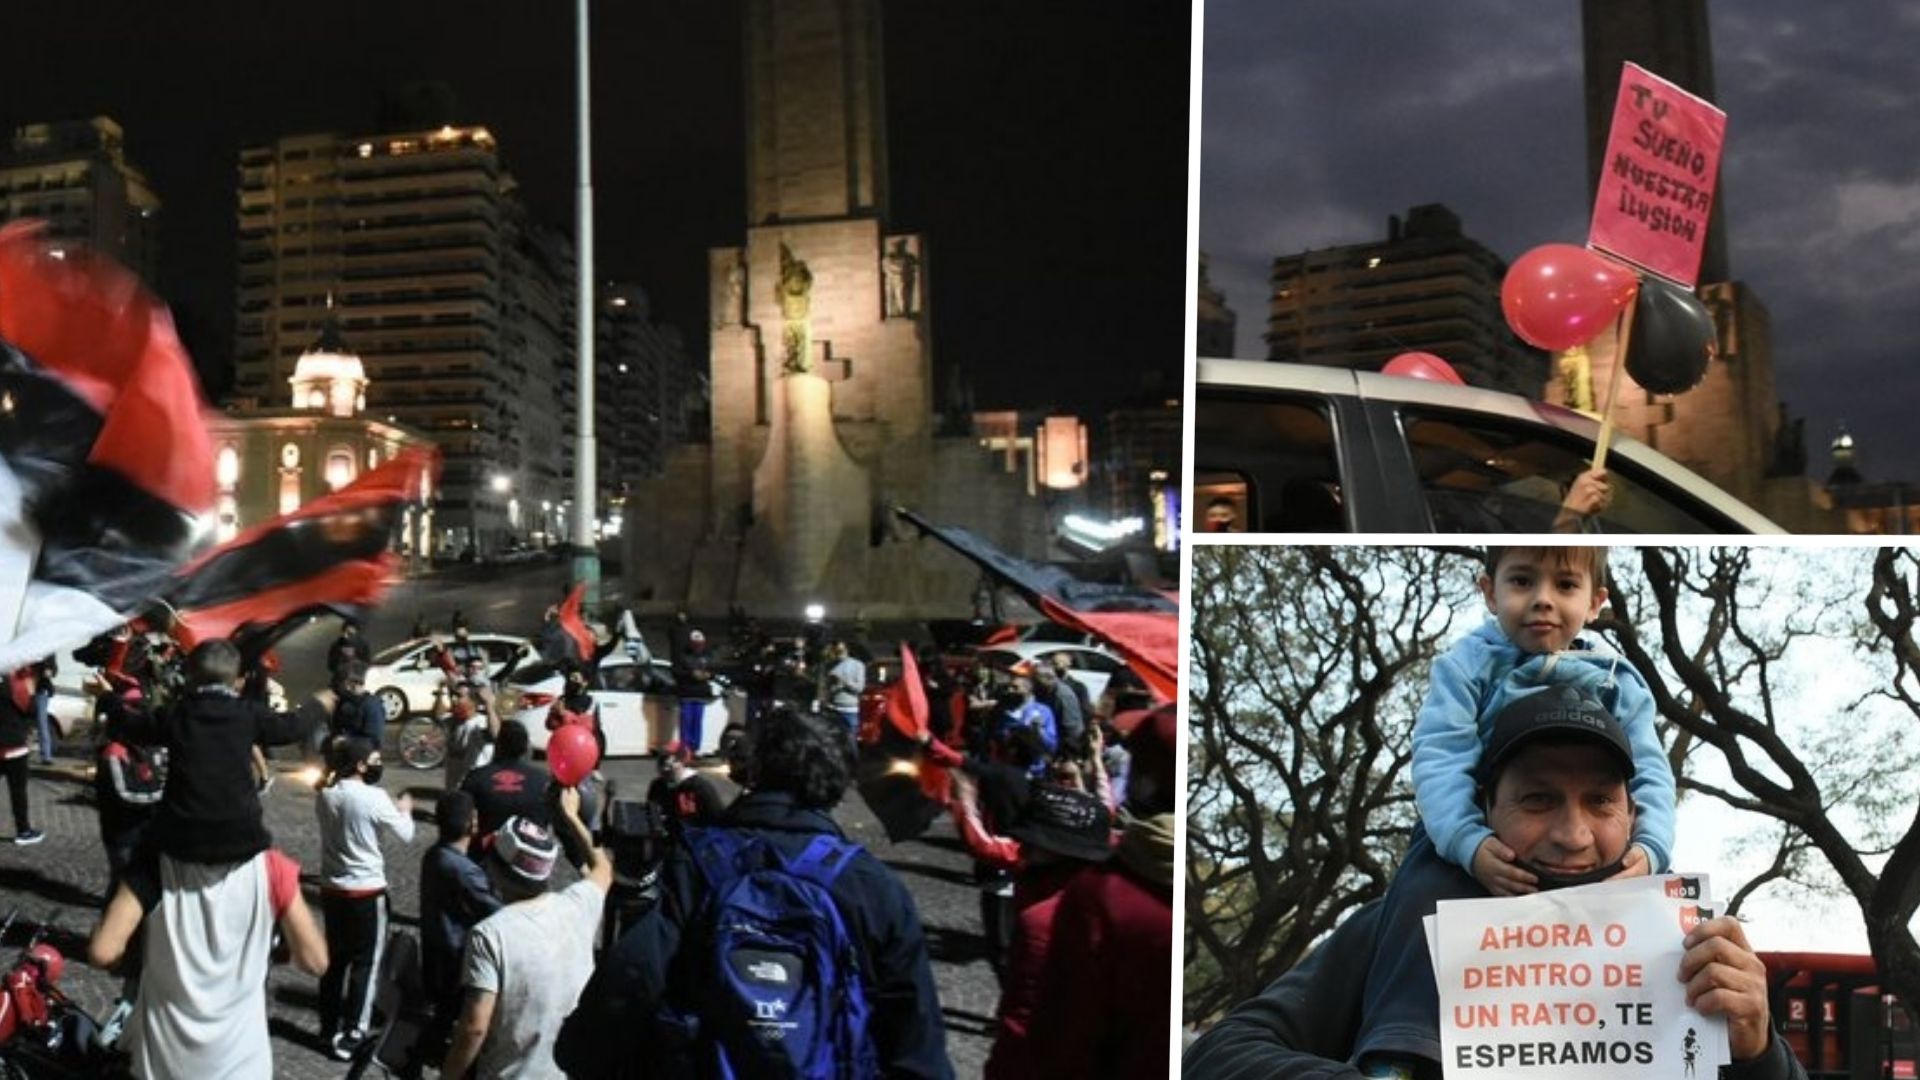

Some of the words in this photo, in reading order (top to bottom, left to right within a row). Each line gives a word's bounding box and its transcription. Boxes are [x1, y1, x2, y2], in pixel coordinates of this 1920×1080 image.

[1629, 84, 1668, 120] TU
[1613, 153, 1711, 213] NUESTRA
[1670, 885, 1696, 898] NOB
[1480, 923, 1593, 951] AHORA
[1604, 923, 1627, 947] O
[1464, 963, 1592, 990] DENTRO
[1603, 964, 1643, 988] DE
[1454, 1004, 1499, 1029] UN
[1511, 1003, 1606, 1030] RATO,
[1615, 1003, 1653, 1026] TE
[1792, 1001, 1804, 1020] 2
[1823, 1002, 1834, 1022] 1
[1456, 1041, 1654, 1069] ESPERAMOS
